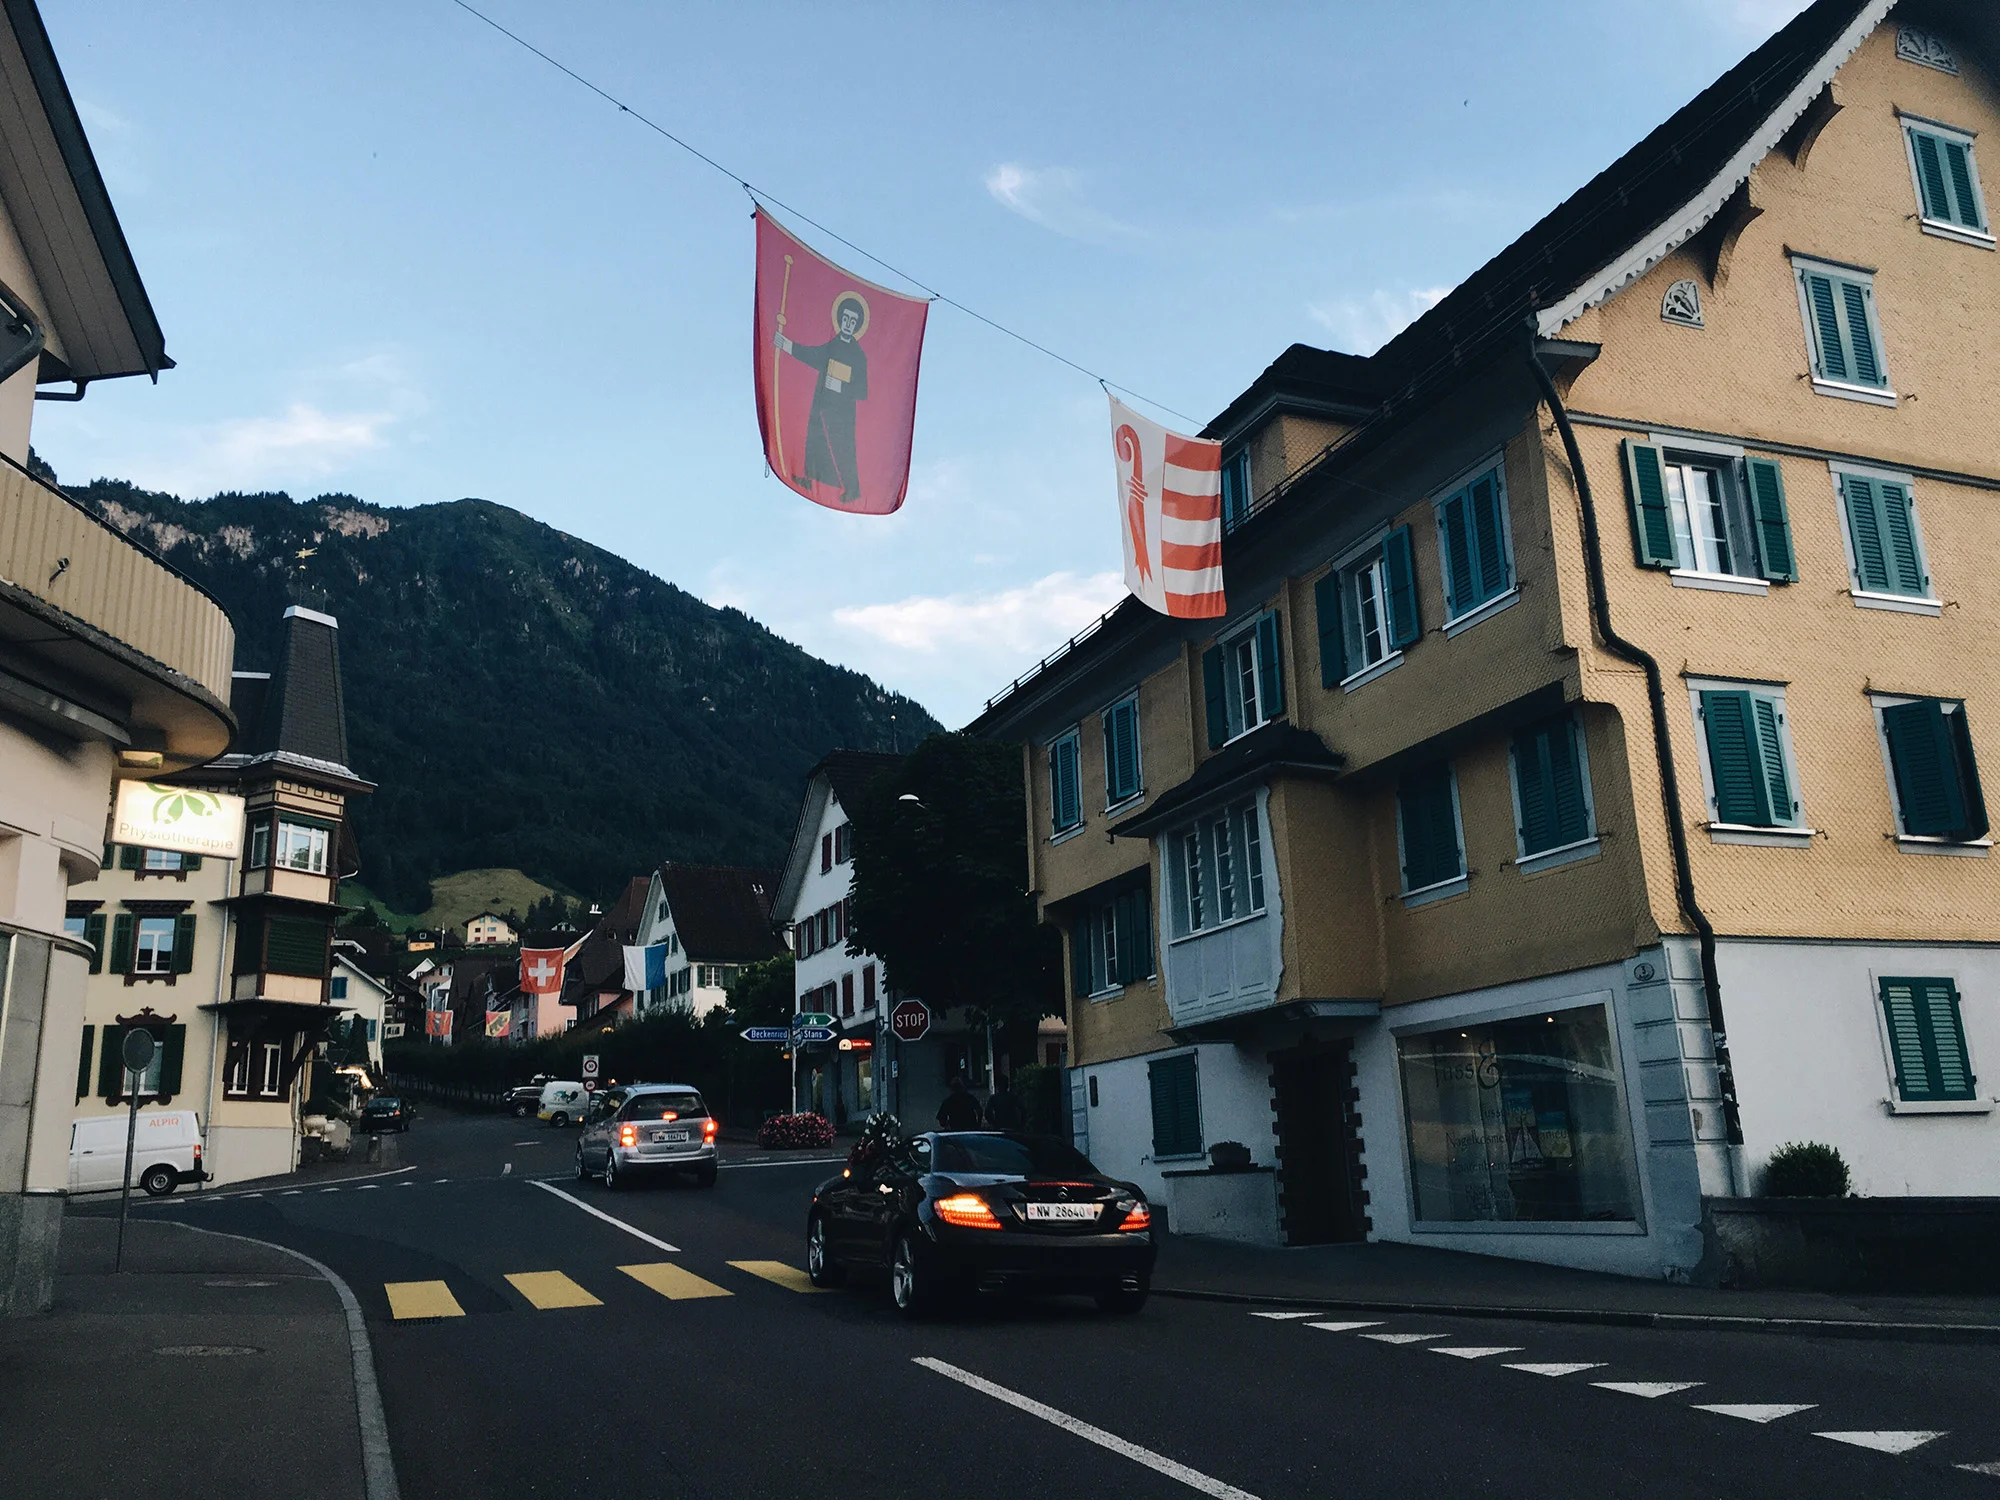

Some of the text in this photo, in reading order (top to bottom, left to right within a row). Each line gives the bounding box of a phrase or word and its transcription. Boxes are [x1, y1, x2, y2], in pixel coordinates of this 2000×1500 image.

[119, 822, 234, 850] Physiotherapie
[896, 1012, 925, 1028] STOP
[751, 1030, 788, 1039] Beckenried
[803, 1030, 823, 1039] Stans
[149, 1117, 179, 1128] ALPIQ
[1036, 1206, 1086, 1218] NW 28640
